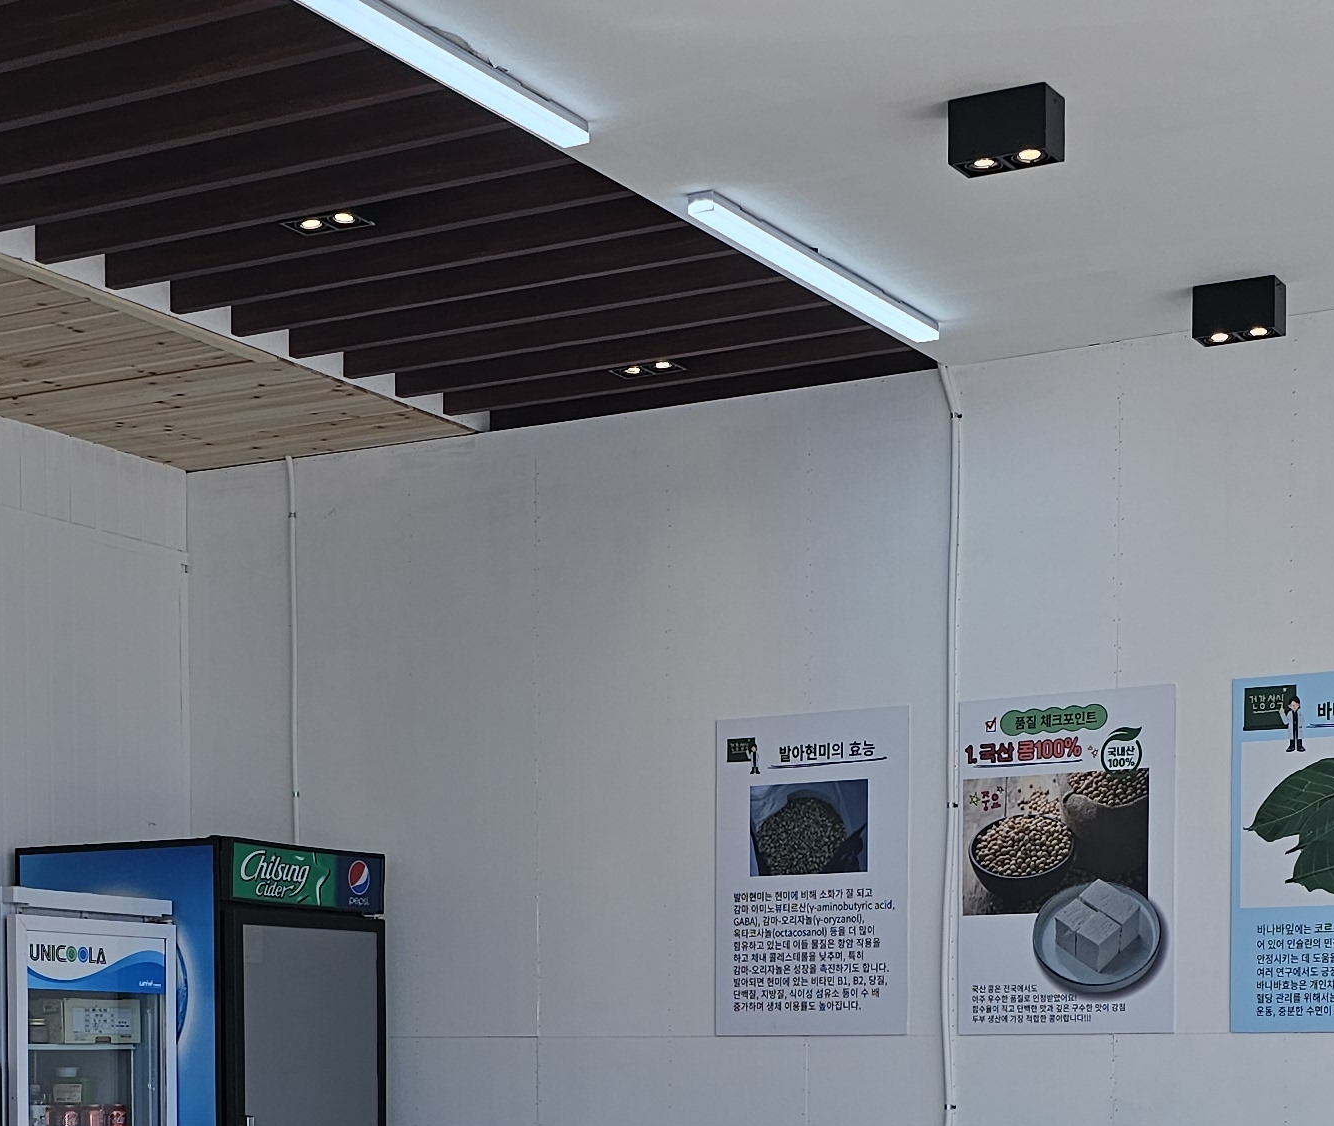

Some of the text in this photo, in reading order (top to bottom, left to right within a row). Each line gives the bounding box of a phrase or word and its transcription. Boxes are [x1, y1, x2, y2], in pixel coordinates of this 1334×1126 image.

[1249, 694, 1284, 710] 건강상식
[1015, 710, 1097, 730] 품질 체크포인트
[778, 741, 876, 763] 발아현미의 효능
[1017, 736, 1082, 759] 콩100%
[1108, 745, 1135, 758] 국내산
[1108, 756, 1136, 769] 100%
[255, 881, 295, 898] Cider
[819, 889, 843, 900] 소화가
[857, 888, 873, 898] 되고
[348, 896, 369, 906] pepsi
[874, 900, 895, 911] acid,
[733, 917, 760, 927] GABA),
[849, 926, 856, 936] 더
[1257, 923, 1312, 936] 바나바잎에는
[767, 940, 790, 950] 있는데
[1257, 940, 1265, 950] 어
[1267, 939, 1284, 950] 있어
[1287, 938, 1321, 949] 인슐린의
[29, 943, 107, 964] UNICOOLA
[733, 953, 748, 963] 하고
[848, 951, 864, 961] 특히
[1257, 953, 1298, 965] 안정시키는
[1301, 952, 1310, 964] 데
[794, 964, 816, 974] 성장을
[863, 963, 889, 973] 합니다.
[1257, 967, 1273, 978] 여러
[1276, 966, 1319, 977] 연구에서도
[793, 976, 808, 987] 있는
[811, 976, 835, 986] 비타민
[837, 977, 850, 987] B1,
[853, 976, 866, 987] B2,
[789, 989, 813, 999] 식이성
[816, 989, 840, 999] 섬유소
[861, 988, 868, 998] 수
[872, 988, 879, 998] 배
[1276, 992, 1301, 1003] 관리를
[819, 1001, 861, 1011] 높아집니다.
[1257, 1006, 1276, 1017] 운동,
[1278, 1006, 1303, 1016] 충분한
[1306, 1005, 1332, 1016] 수면이
